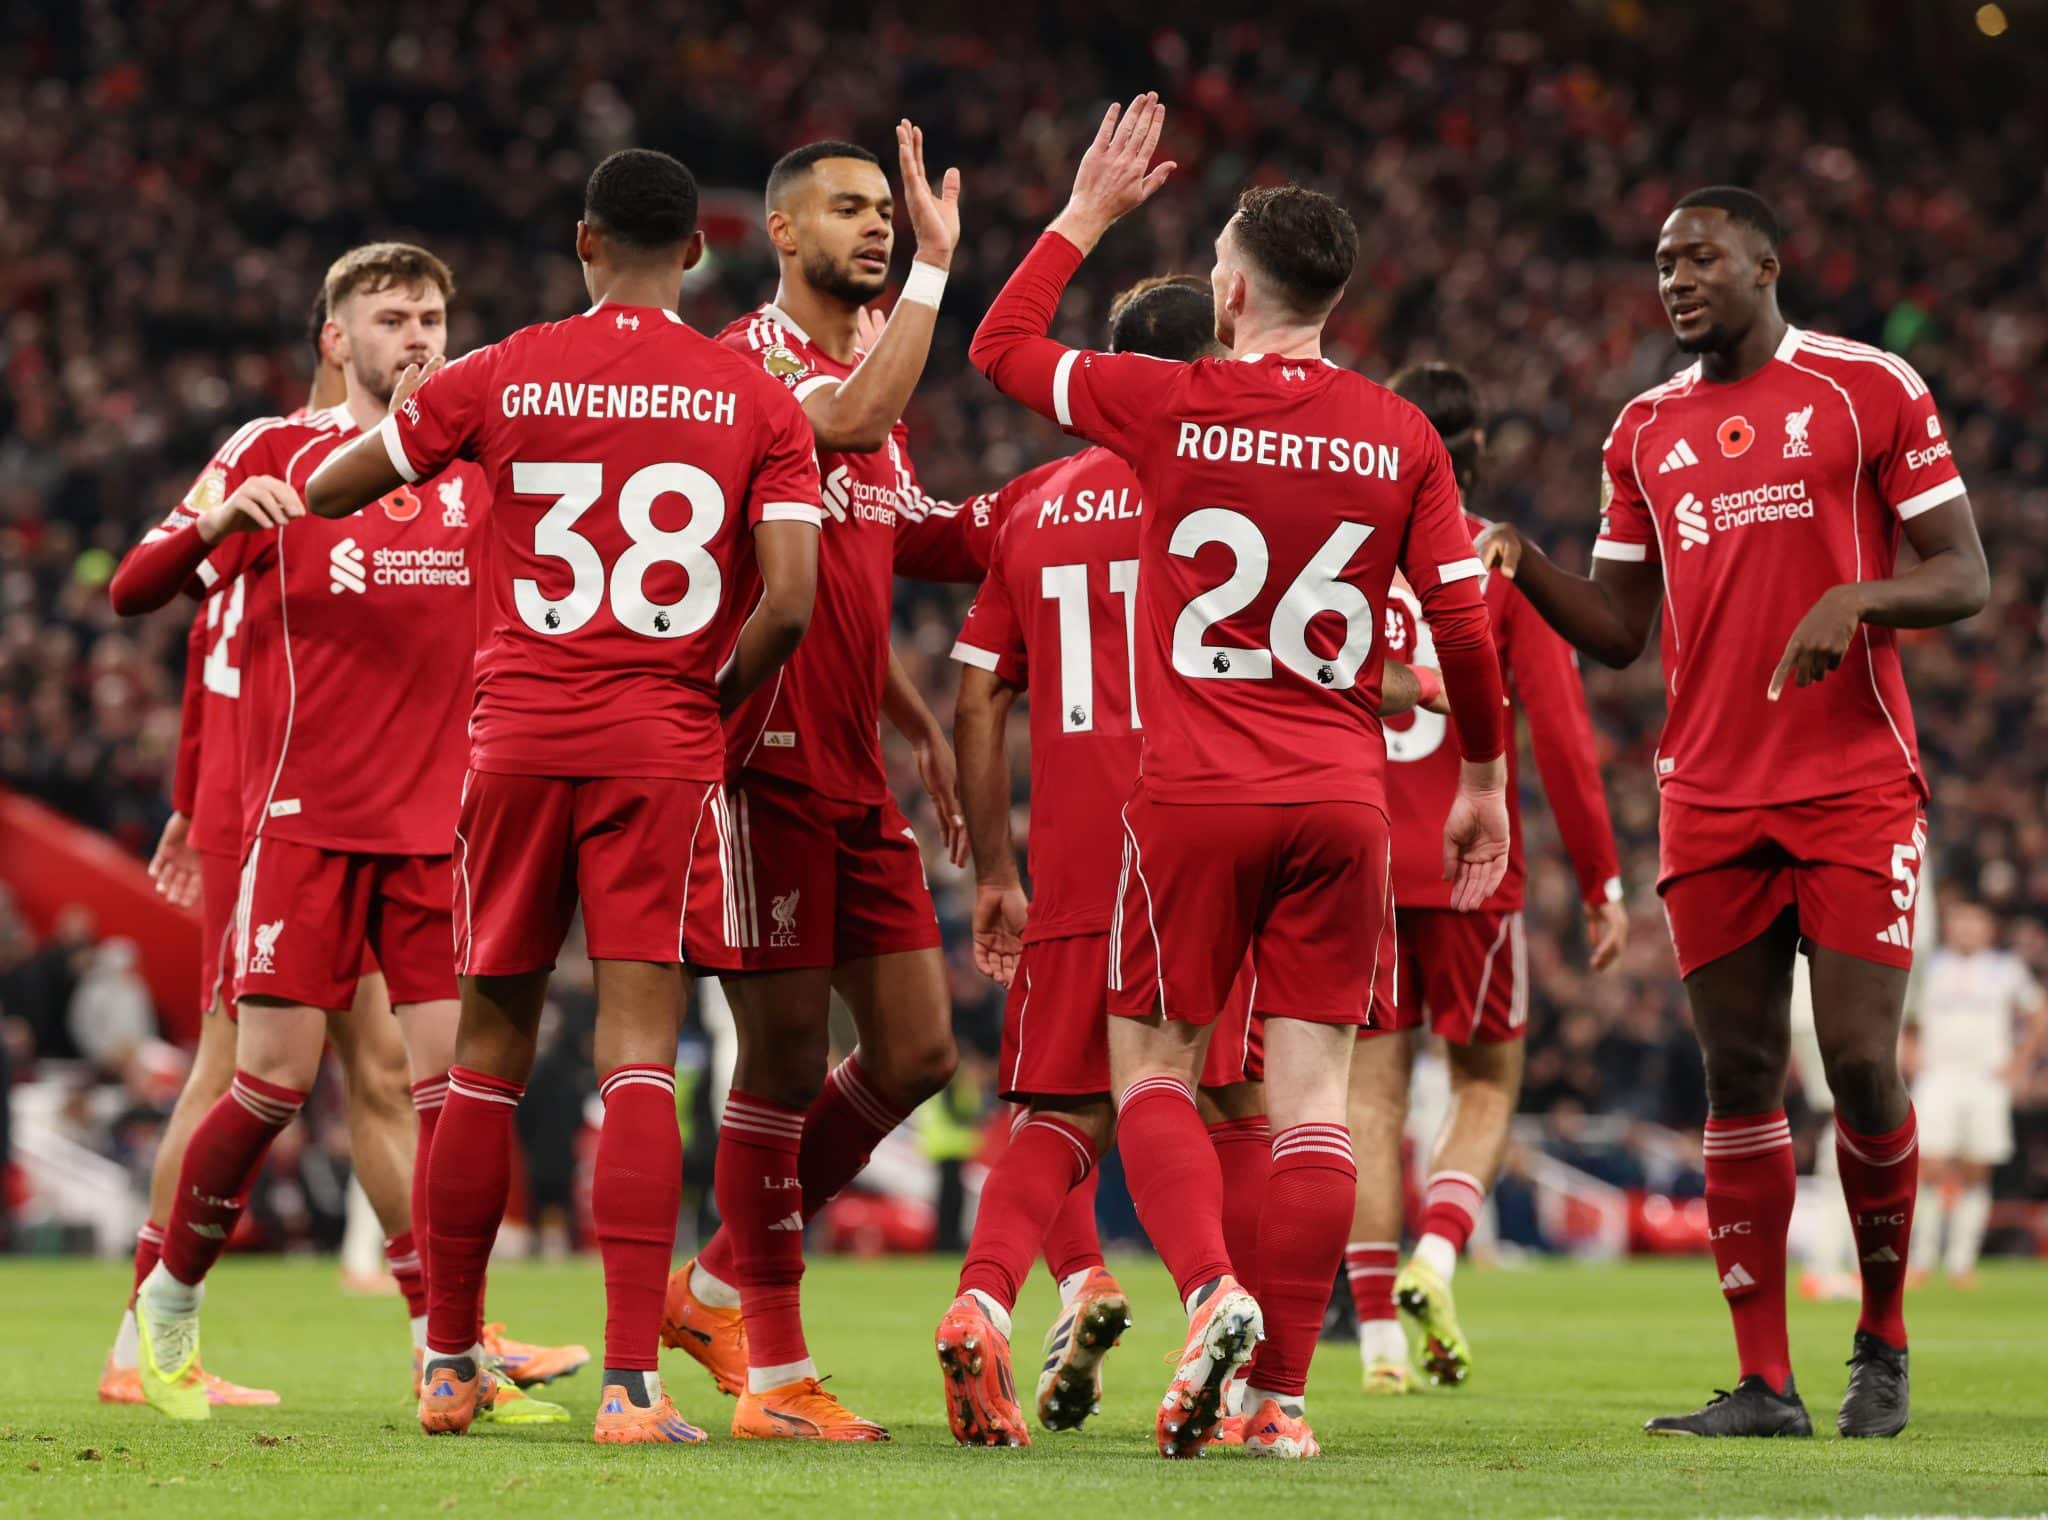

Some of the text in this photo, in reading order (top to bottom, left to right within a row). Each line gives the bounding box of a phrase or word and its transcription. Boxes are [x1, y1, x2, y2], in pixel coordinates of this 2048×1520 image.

[501, 382, 736, 426] GRAVENBERCH
[1176, 422, 1399, 481] ROBERTSON
[1711, 480, 1806, 514] standard
[1713, 498, 1814, 532] chartered
[372, 547, 466, 568] standard
[511, 462, 726, 638] 38
[373, 567, 471, 586] chartered
[1168, 507, 1376, 690] 26
[1891, 844, 1917, 911] 5
